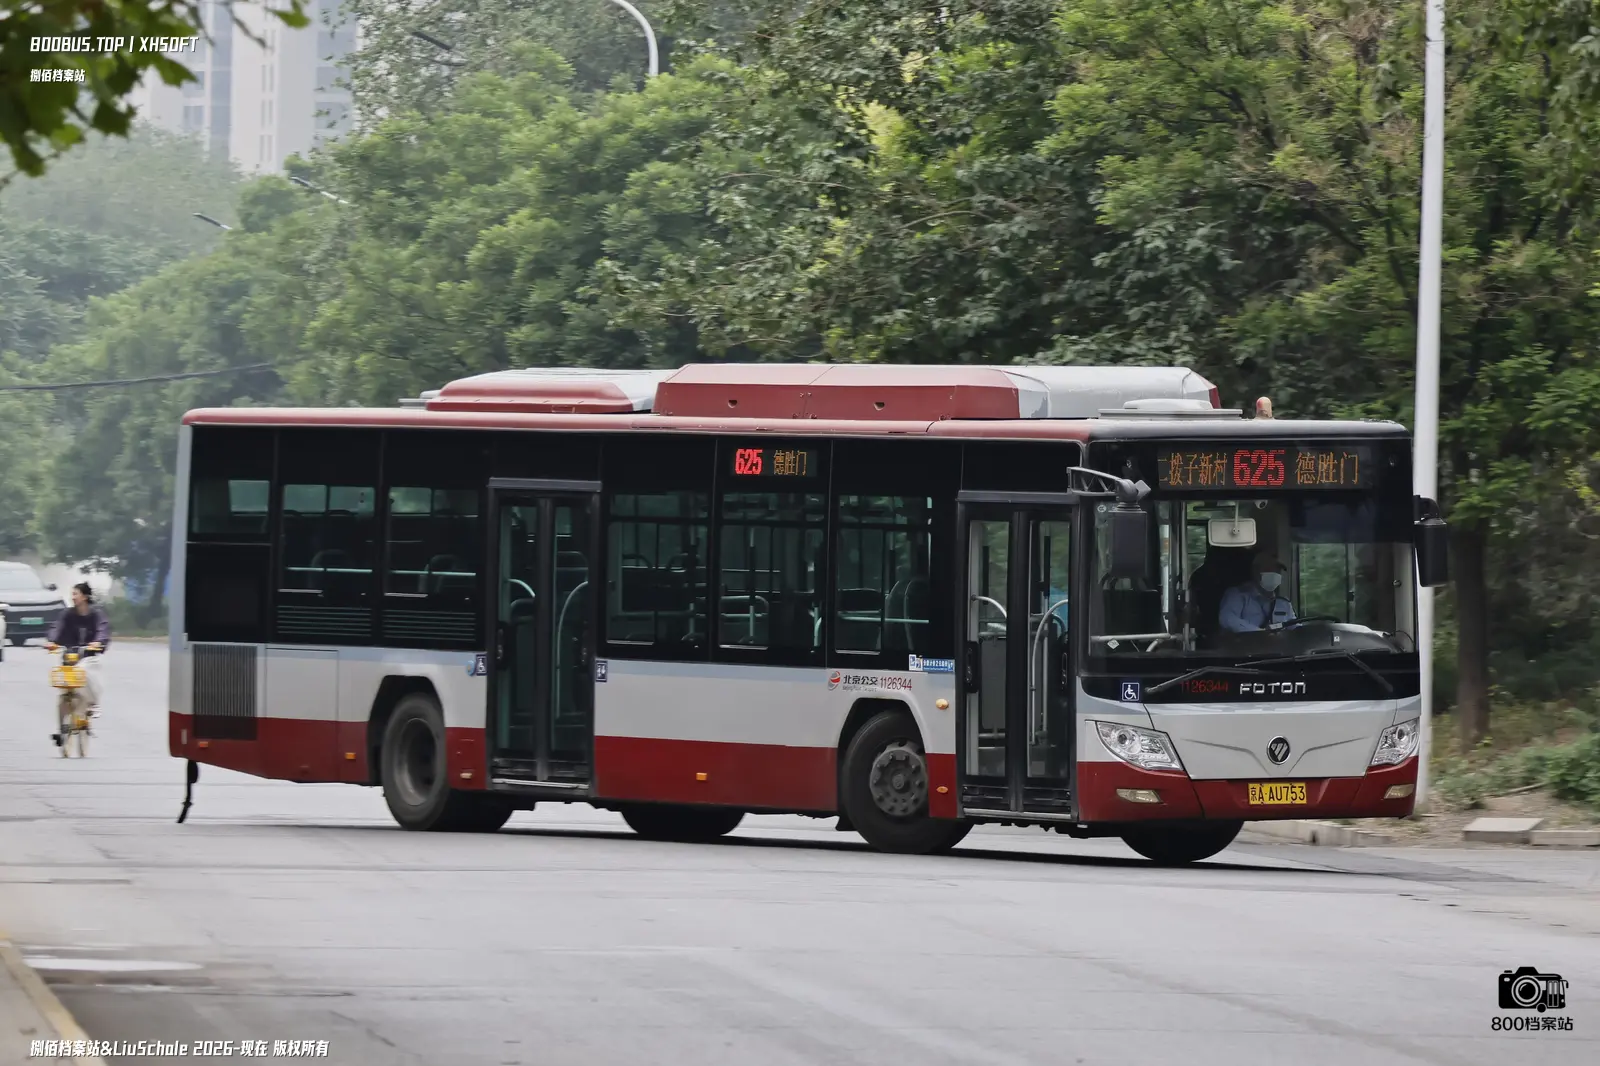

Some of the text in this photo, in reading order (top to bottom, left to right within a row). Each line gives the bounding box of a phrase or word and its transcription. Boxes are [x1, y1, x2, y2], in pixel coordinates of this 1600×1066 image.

[735, 448, 807, 475] 625 德胜门
[1233, 449, 1285, 487] 625
[1295, 451, 1359, 485] 德胜门
[843, 674, 879, 686] 北京公交
[880, 676, 912, 691] 1126344
[1179, 679, 1306, 695] 1126344 FOTON
